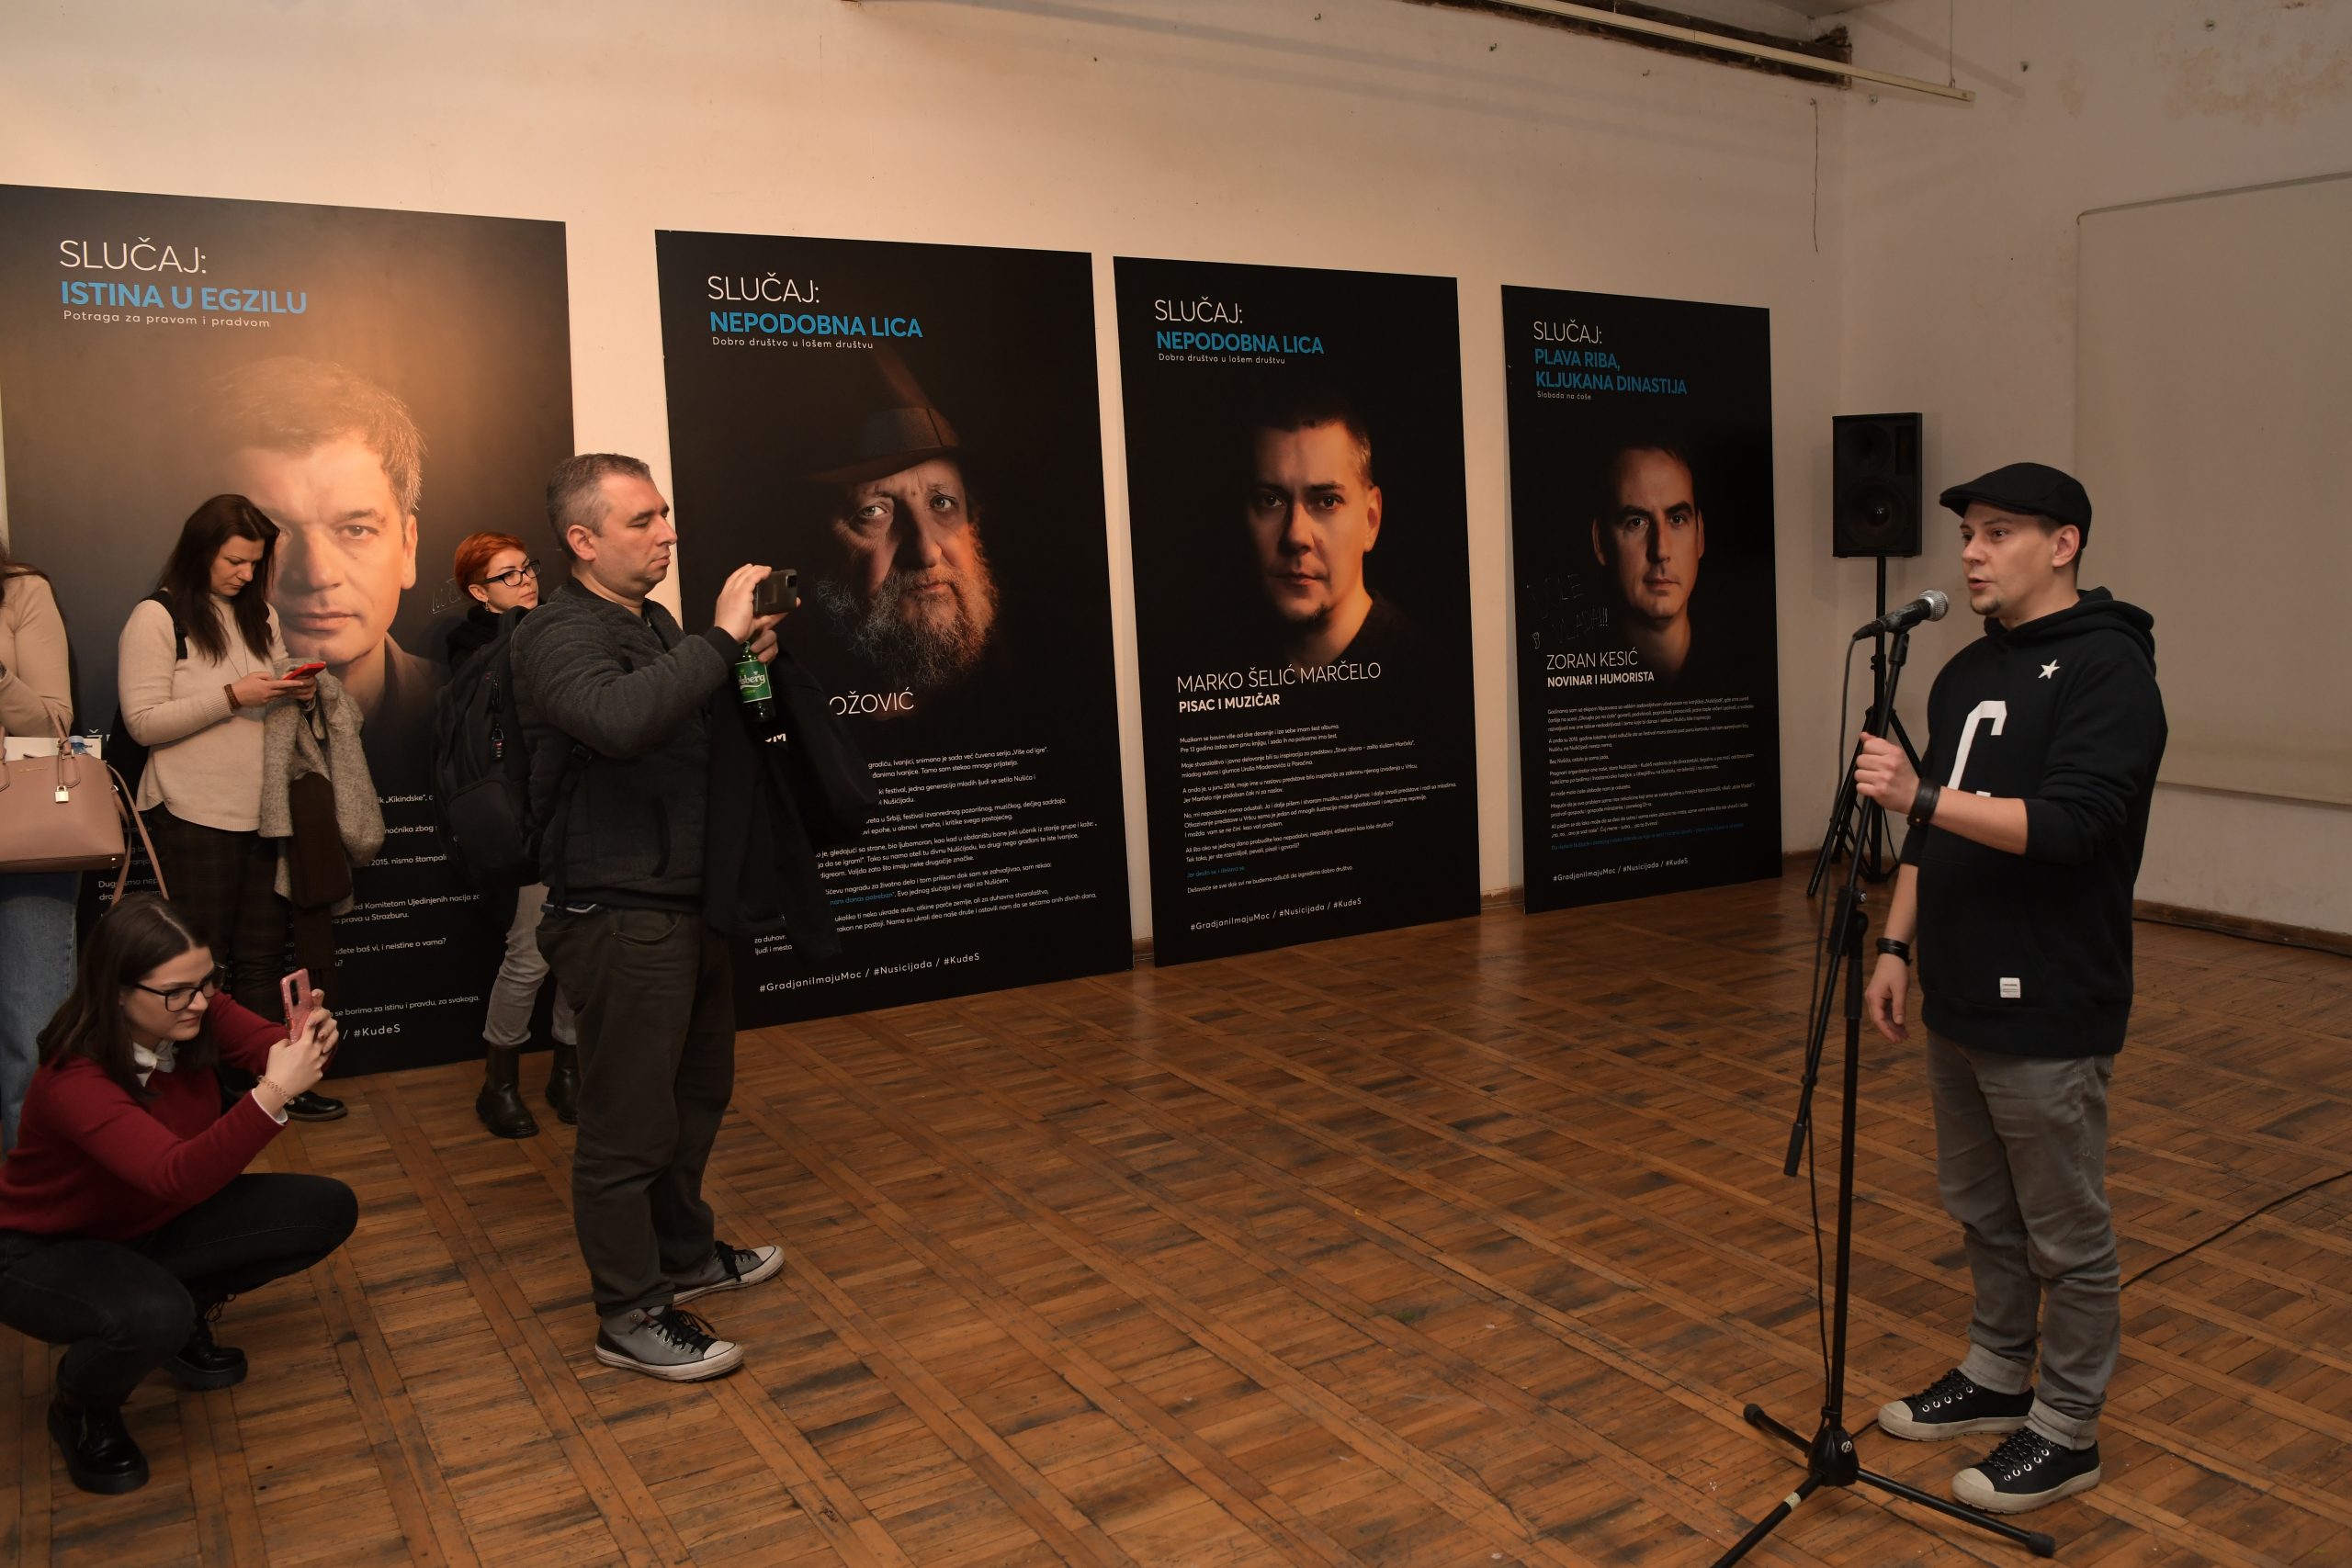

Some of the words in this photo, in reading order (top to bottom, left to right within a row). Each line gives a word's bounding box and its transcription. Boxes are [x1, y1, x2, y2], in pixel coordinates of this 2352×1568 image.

[59, 236, 207, 275] SLUČAJ:
[62, 280, 164, 309] ISTINA
[171, 286, 193, 310] U
[200, 288, 307, 315] EGZILU
[707, 272, 820, 304] SLUČAJ:
[63, 310, 119, 324] Potraga
[125, 314, 141, 323] za
[146, 314, 198, 325] pravom
[202, 315, 207, 325] i
[211, 317, 270, 328] pradvom
[1154, 296, 1243, 324] SLUČAJ:
[709, 311, 866, 337] NEPODOBNA
[871, 316, 923, 338] LICA
[1533, 319, 1602, 344] SLUČAJ:
[712, 336, 745, 346] Dobro
[749, 337, 788, 348] društvo
[802, 339, 832, 349] lošem
[835, 339, 874, 350] društvu
[1156, 331, 1280, 353] NEPODOBNA
[1283, 335, 1325, 355] LICA
[1159, 353, 1184, 362] Dobro
[1187, 354, 1219, 364] društvo
[1228, 355, 1253, 364] lošem
[1255, 355, 1286, 365] društvu
[1534, 348, 1581, 367] PLAVA
[1584, 351, 1621, 372] RIBA,
[1535, 371, 1613, 391] KLJUKANA
[1616, 375, 1688, 395] DINASTIJA
[1537, 390, 1565, 400] Sloboda
[1546, 651, 1596, 670] ZORAN
[1600, 647, 1638, 667] KESIĆ
[1177, 671, 1243, 694] MARKO
[1248, 664, 1295, 688] ŠELIĆ
[1300, 660, 1381, 684] MARČELO
[1547, 674, 1593, 688] NOVINAR
[1594, 674, 1598, 684] I
[1600, 671, 1655, 684] HUMORISTA
[829, 686, 914, 716] OŽOVIĆ
[1179, 698, 1216, 714] PISAC
[1217, 698, 1222, 710] I
[1225, 693, 1280, 709] MUZIČAR
[940, 754, 947, 762] je
[947, 752, 963, 761] sada
[920, 765, 938, 774] Tamo
[951, 762, 971, 772] stekao
[971, 761, 993, 771] mnogo
[383, 823, 413, 835] oćnika
[414, 823, 435, 834] zbog
[370, 857, 390, 866] 2015.
[390, 855, 413, 864] nismo
[414, 852, 447, 863] štampali
[1623, 861, 1659, 873] #Nusicijada
[1666, 857, 1689, 867] #KudeS
[819, 869, 846, 880] digreom.
[866, 865, 882, 874] zato
[909, 860, 924, 868] neke
[365, 897, 406, 910] Komitetom
[407, 894, 448, 908] Ujedinjenih
[448, 893, 471, 904] nacija
[341, 916, 363, 924] prava
[862, 909, 878, 919] neko
[1190, 911, 1270, 931] #GradjaniImajuMoc
[1279, 904, 1325, 918] #Nusicijada
[1333, 897, 1362, 909] #KudeS
[356, 944, 370, 953] baš
[385, 940, 413, 951] neistine
[422, 936, 447, 947] vama?
[759, 970, 862, 993] #GradjaniImajuMoc
[873, 958, 933, 976] #Nusicijada
[944, 953, 980, 965] #KudeS
[345, 1004, 372, 1016] borimo
[384, 1001, 403, 1011] istinu
[409, 998, 436, 1010] pravdu,
[353, 1024, 401, 1038] #KudeS
